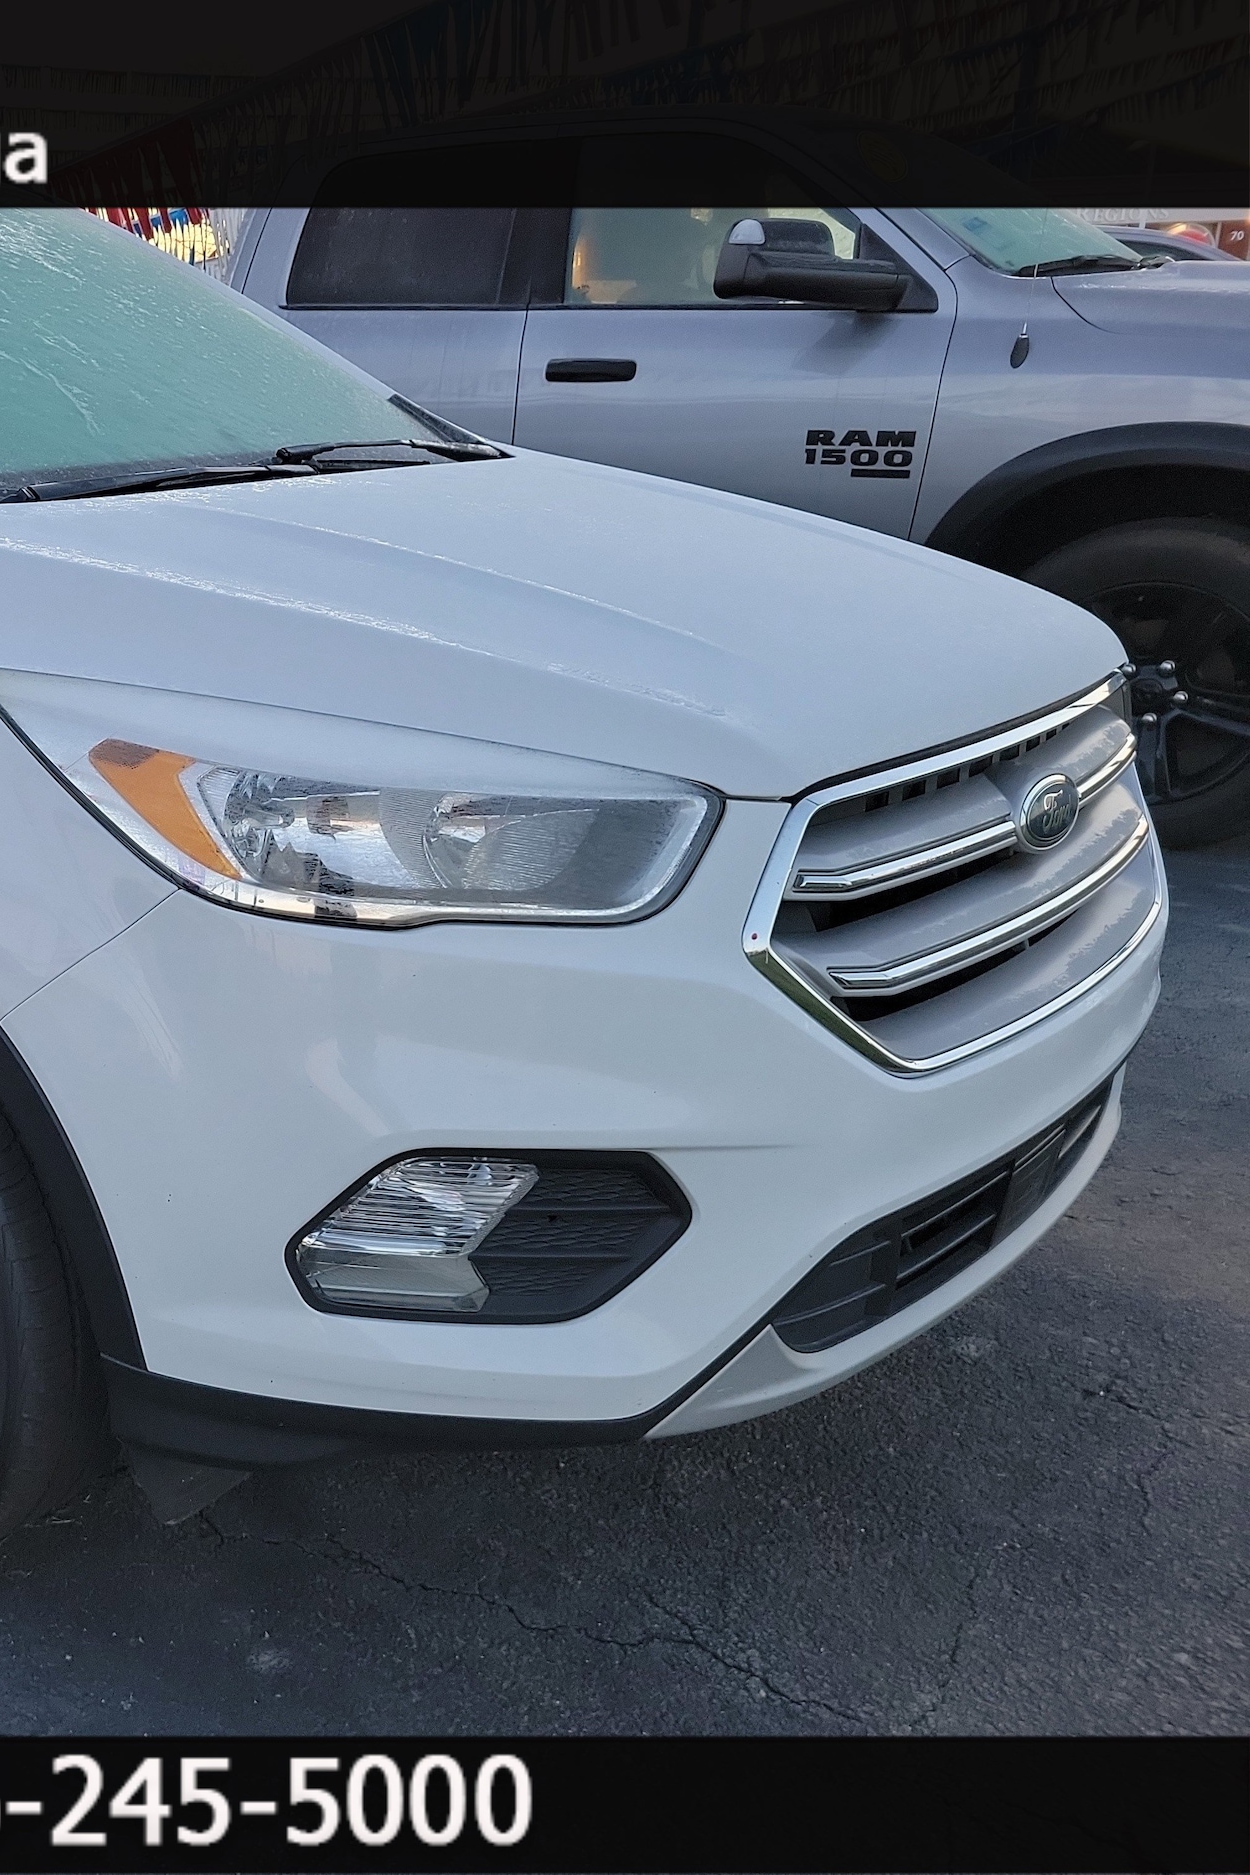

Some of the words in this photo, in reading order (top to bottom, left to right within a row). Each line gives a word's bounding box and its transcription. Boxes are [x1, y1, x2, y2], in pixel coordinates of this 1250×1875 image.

[1230, 231, 1244, 241] 70
[805, 430, 917, 447] RAM
[805, 448, 913, 467] 1500
